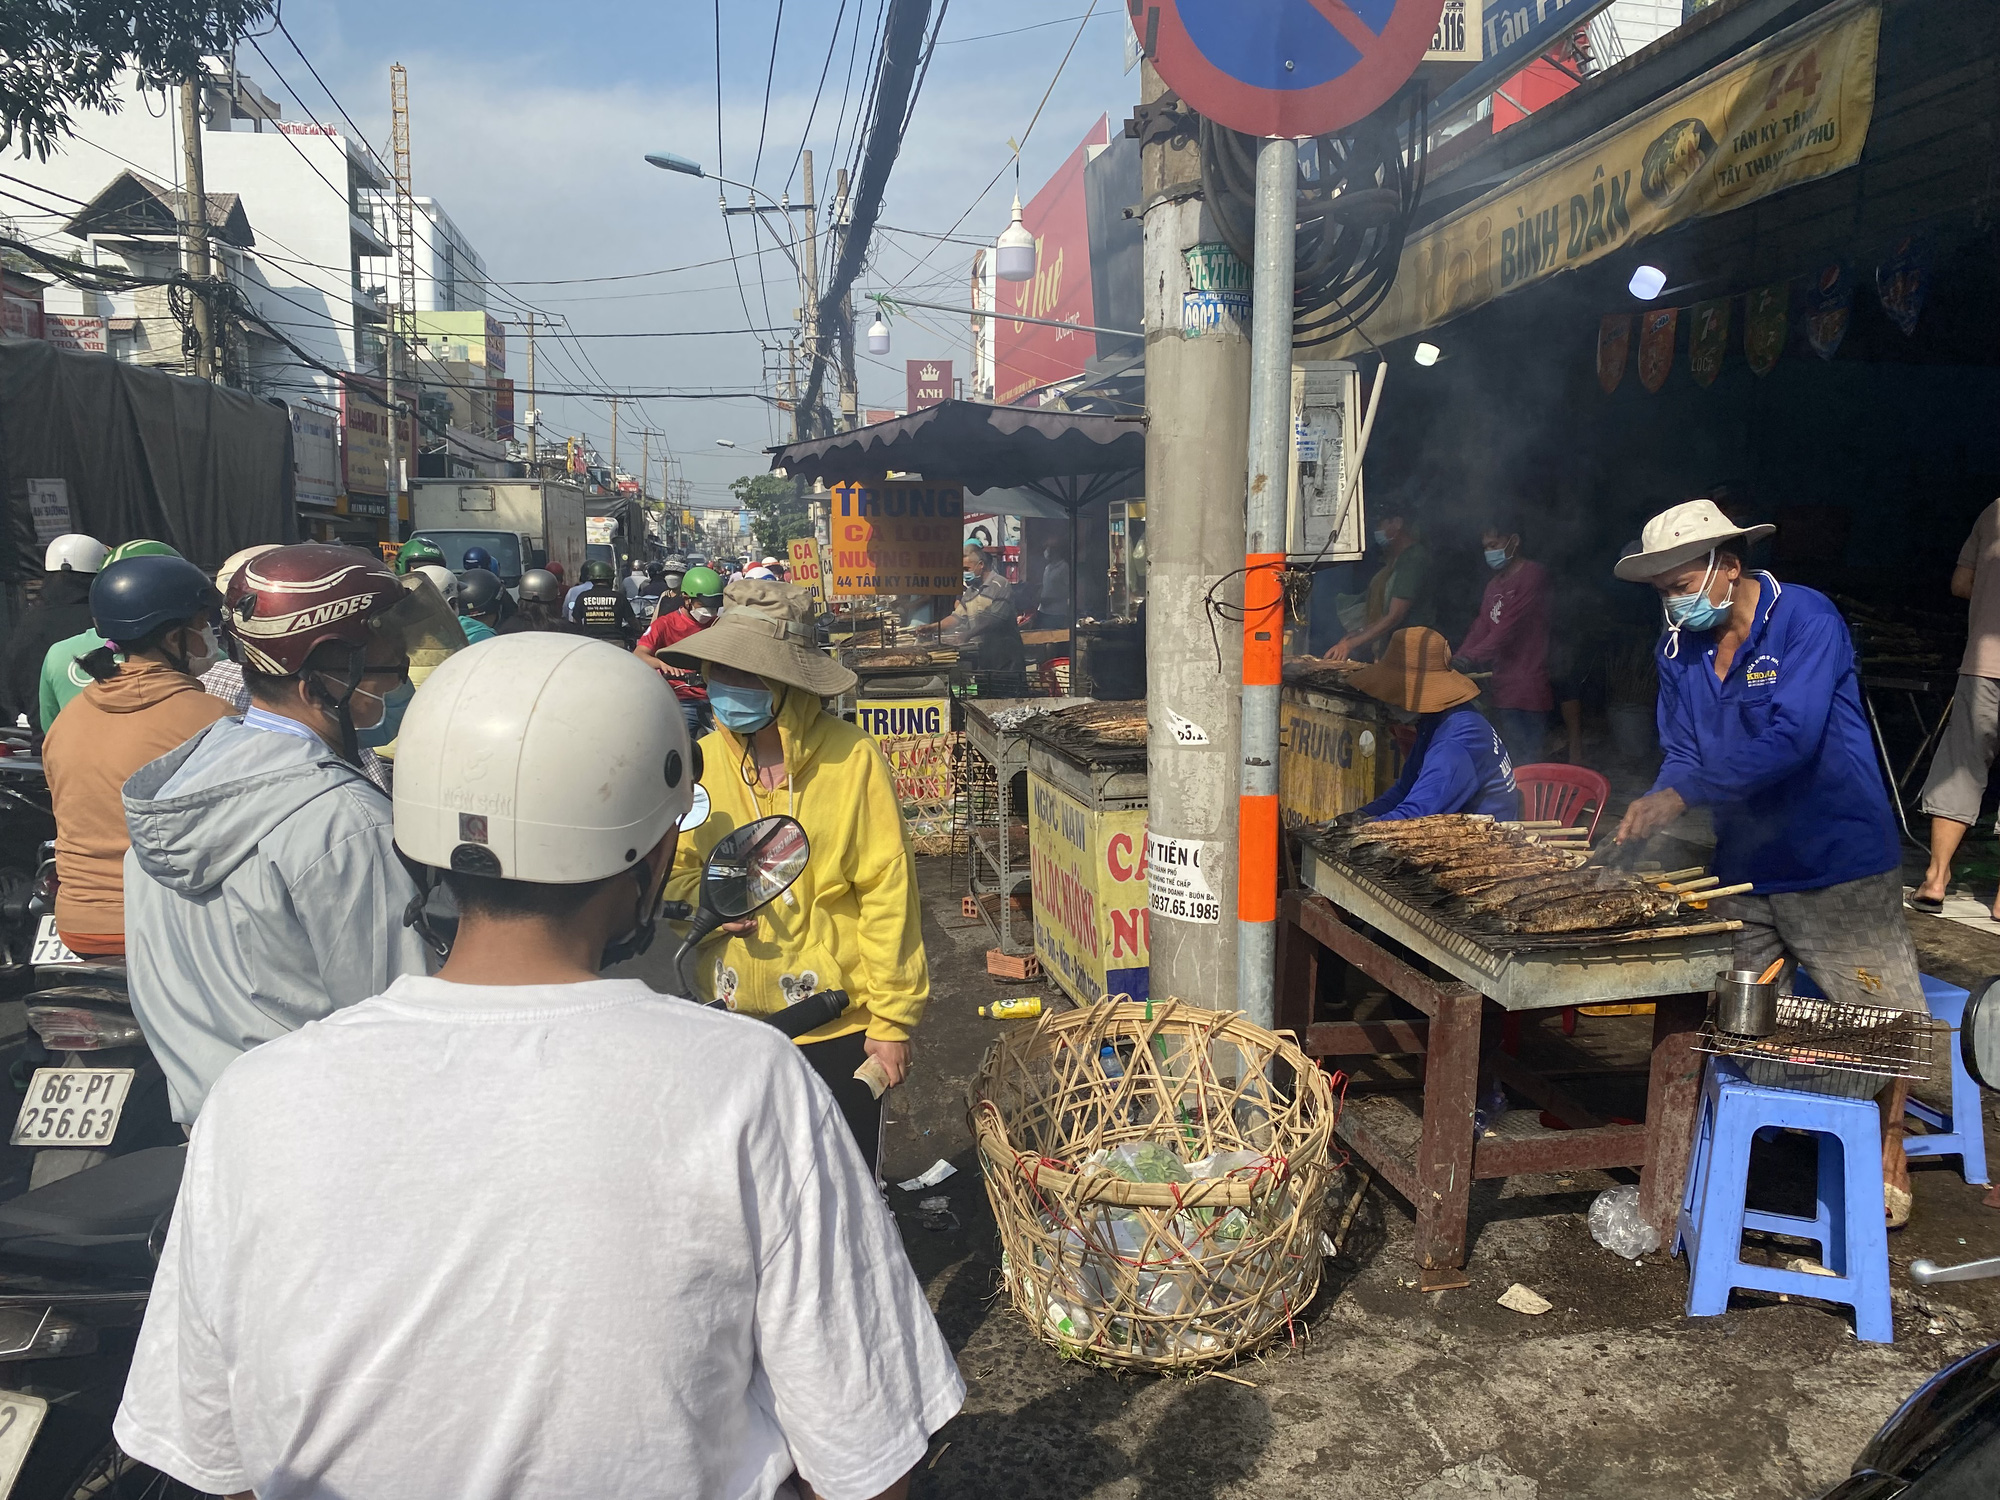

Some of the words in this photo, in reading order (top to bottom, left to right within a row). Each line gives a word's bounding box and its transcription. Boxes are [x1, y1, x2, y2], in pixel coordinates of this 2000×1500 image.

[1484, 7, 1529, 57] Tân
[1806, 117, 1836, 146] PHÚ
[1500, 206, 1559, 289] BÌNH
[1566, 164, 1632, 260] DÂN
[52, 329, 99, 339] CHUYÊN
[84, 342, 104, 351] NHI
[917, 389, 943, 398] ANH
[351, 503, 367, 512] MINH
[368, 502, 386, 515] HÙNG
[836, 488, 961, 518] TRUNG
[794, 540, 813, 560] CÁ
[793, 562, 819, 581] LÓC
[836, 575, 853, 588] 44
[856, 573, 881, 588] TÂN
[291, 594, 373, 632] ANDES
[583, 597, 617, 606] SECURITY
[859, 706, 940, 735] TRUNG
[1290, 716, 1353, 769] TRUNG
[1033, 784, 1059, 834] NGỌC
[1061, 800, 1086, 852] NAM
[1157, 839, 1188, 867] TIỀN
[1151, 893, 1219, 920] 0937.65.1985
[42, 1074, 115, 1104] 66-P1
[19, 1106, 114, 1139] 256.63
